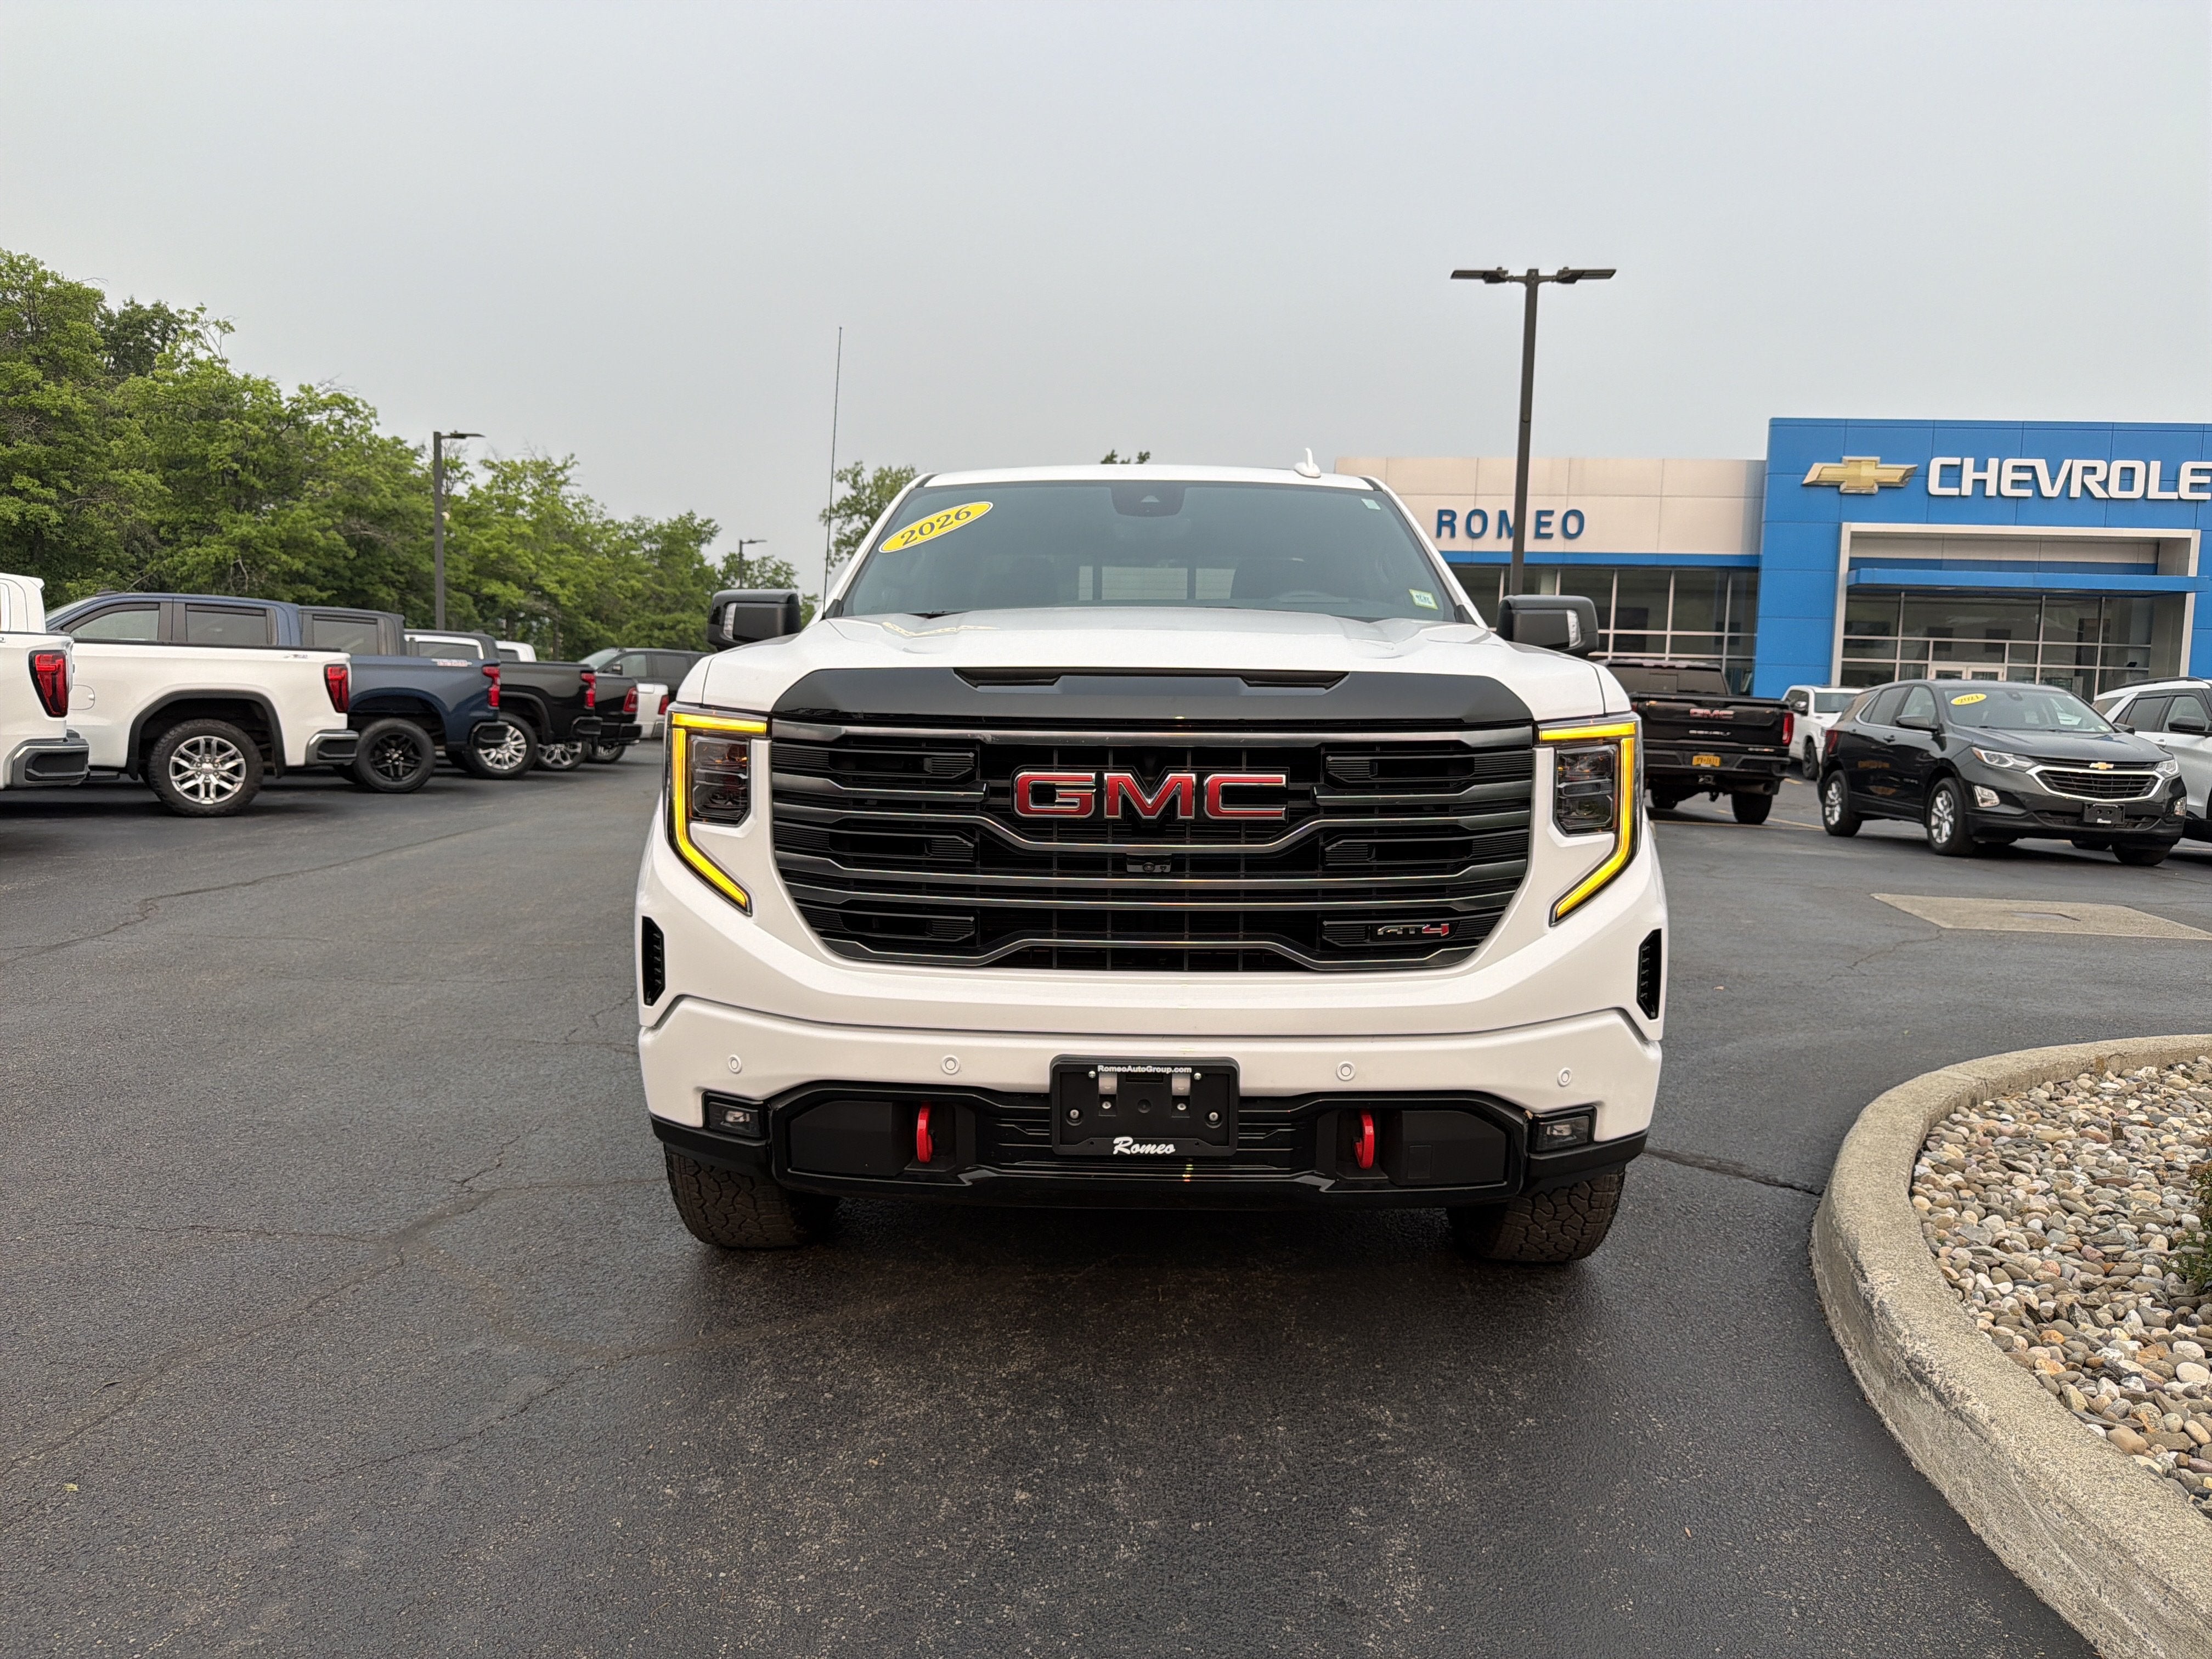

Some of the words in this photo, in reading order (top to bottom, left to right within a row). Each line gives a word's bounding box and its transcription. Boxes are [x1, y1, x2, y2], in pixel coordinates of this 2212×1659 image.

[1928, 456, 2212, 500] CHEVROLE
[900, 506, 972, 546] 2026
[1436, 509, 1585, 539] ROMEO
[1690, 708, 1734, 719] GMC
[1014, 772, 1286, 820] GMC
[1377, 923, 1450, 936] AT4
[1097, 1065, 1192, 1074] RomeoAutoGroup.com
[1113, 1136, 1176, 1155] Romeo
